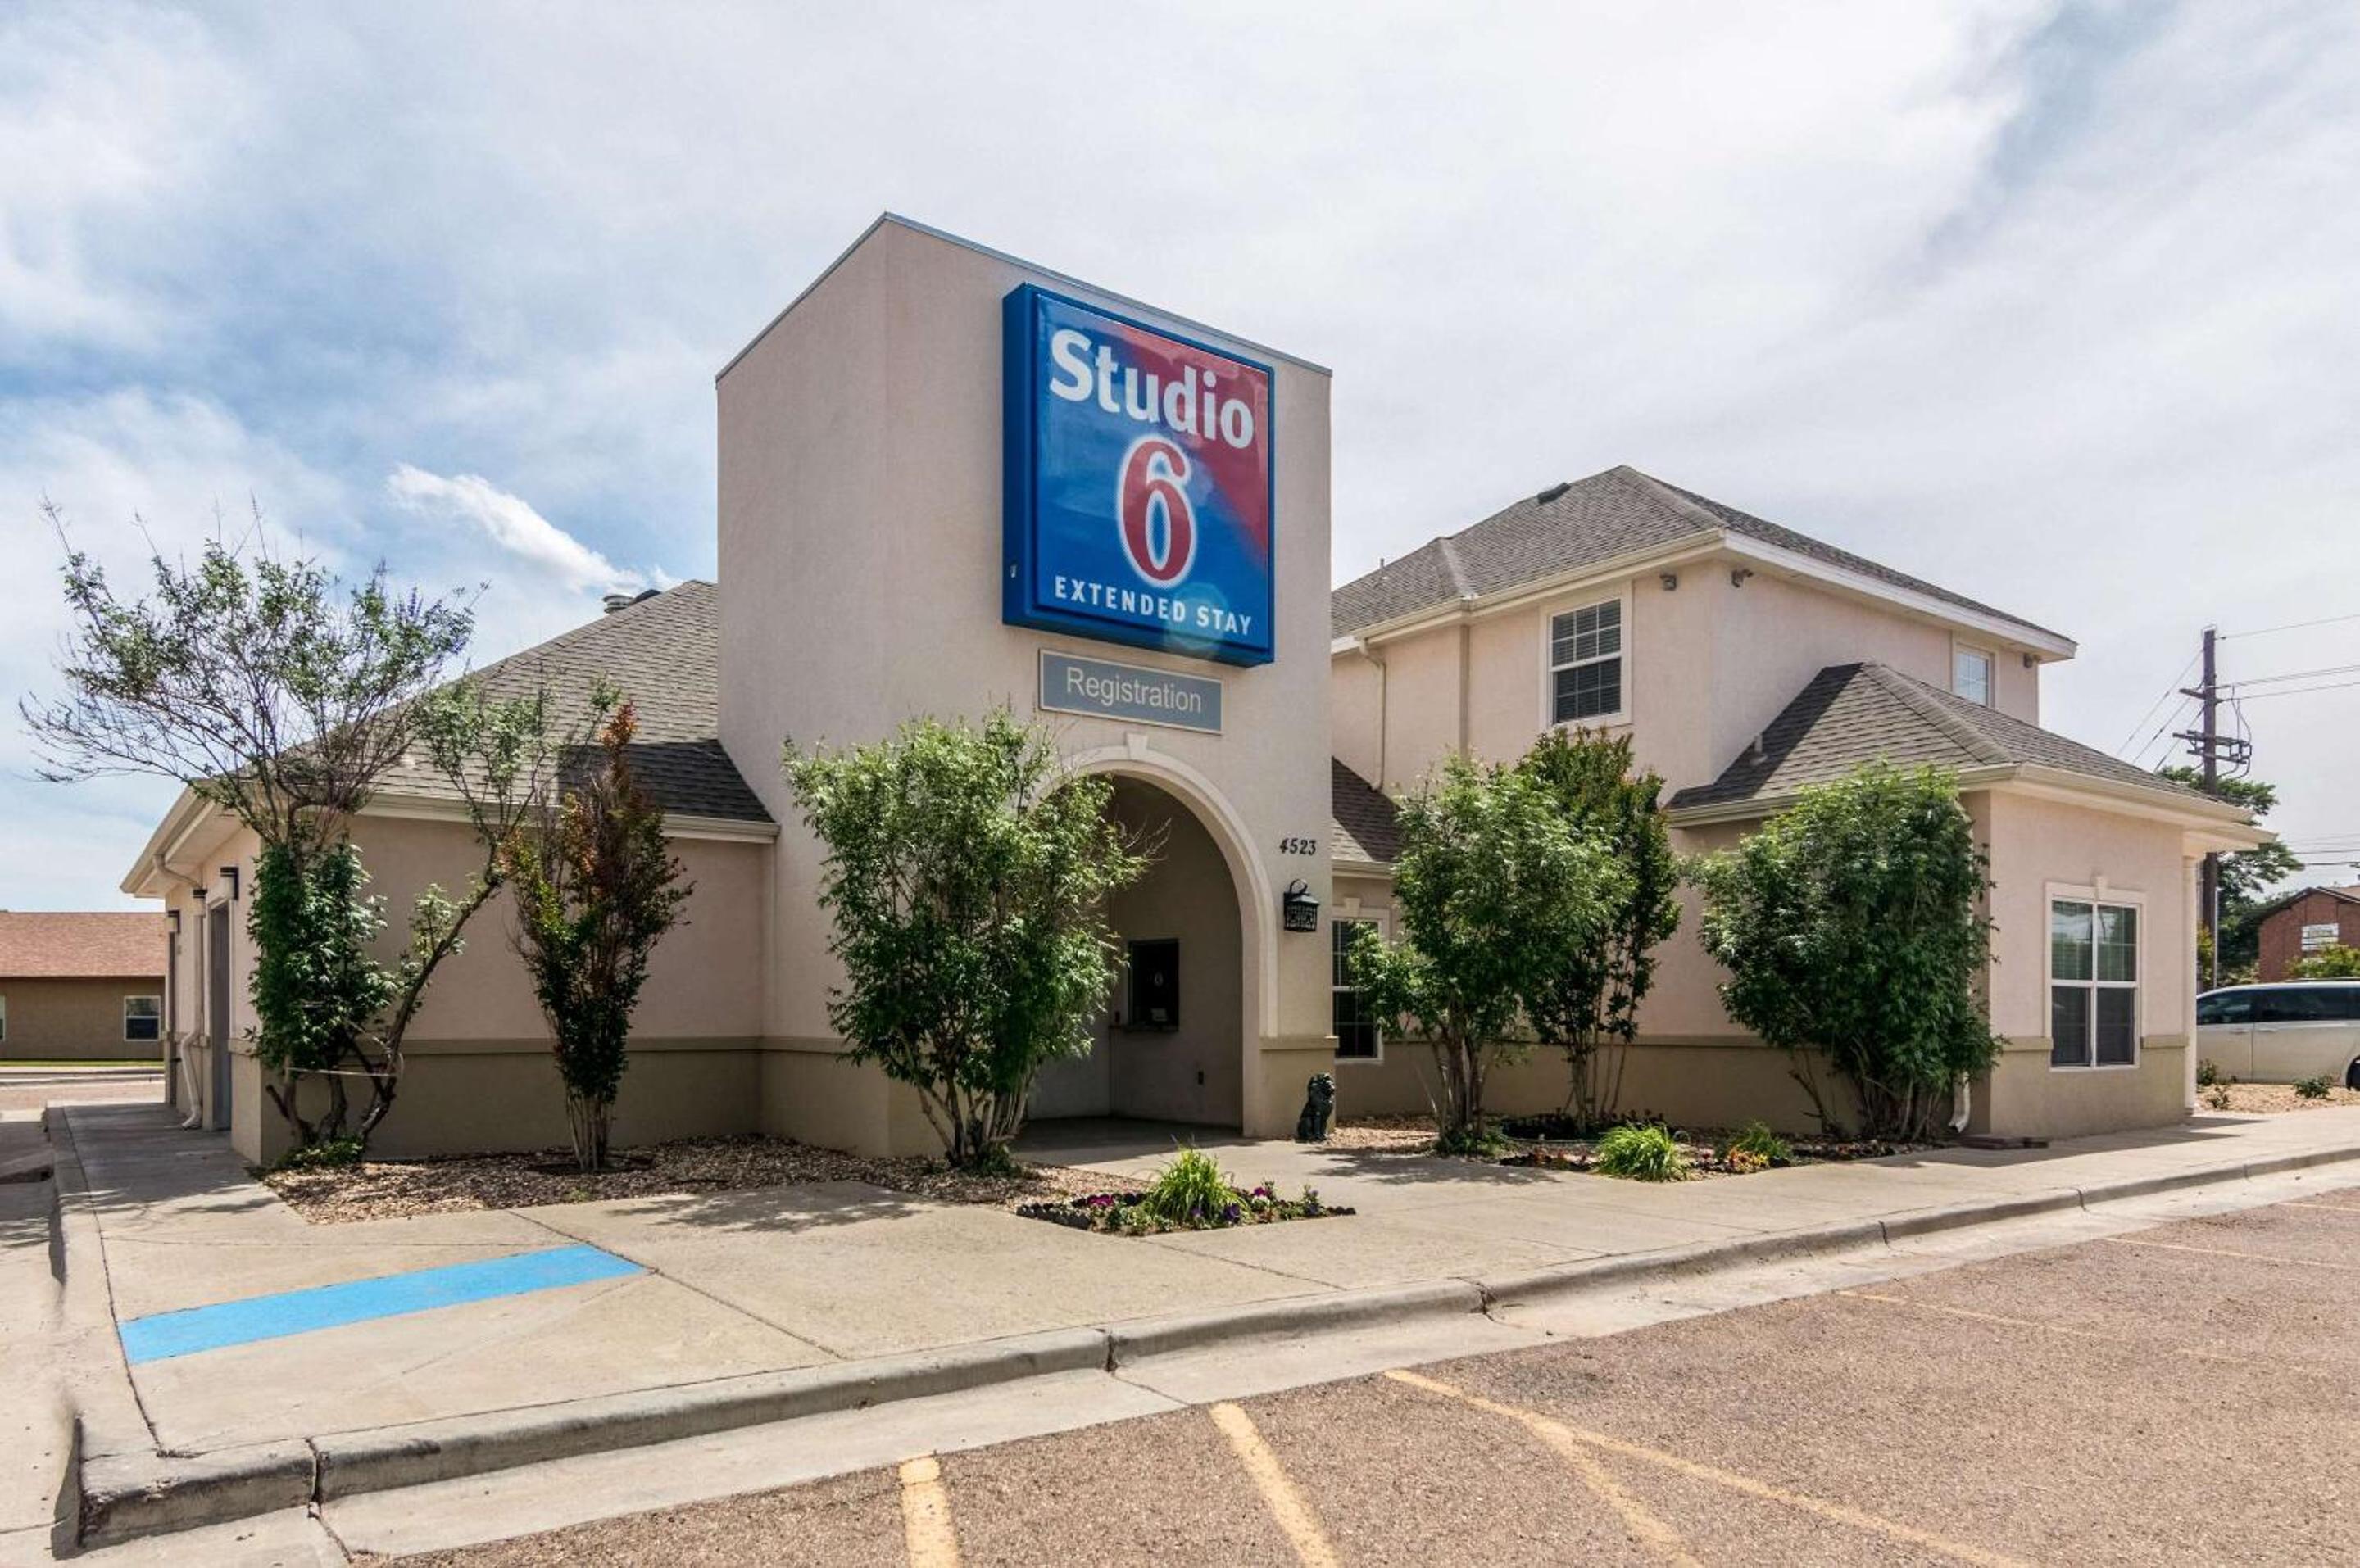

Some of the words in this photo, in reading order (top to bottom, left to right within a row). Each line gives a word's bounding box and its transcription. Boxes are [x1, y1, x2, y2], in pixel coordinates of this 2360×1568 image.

[1050, 329, 1255, 449] Studio
[1117, 434, 1196, 589] 6
[1055, 575, 1186, 623] EXTENDED
[1196, 605, 1251, 636] STAY
[1067, 666, 1202, 714] Registration
[1279, 837, 1317, 856] 4523
